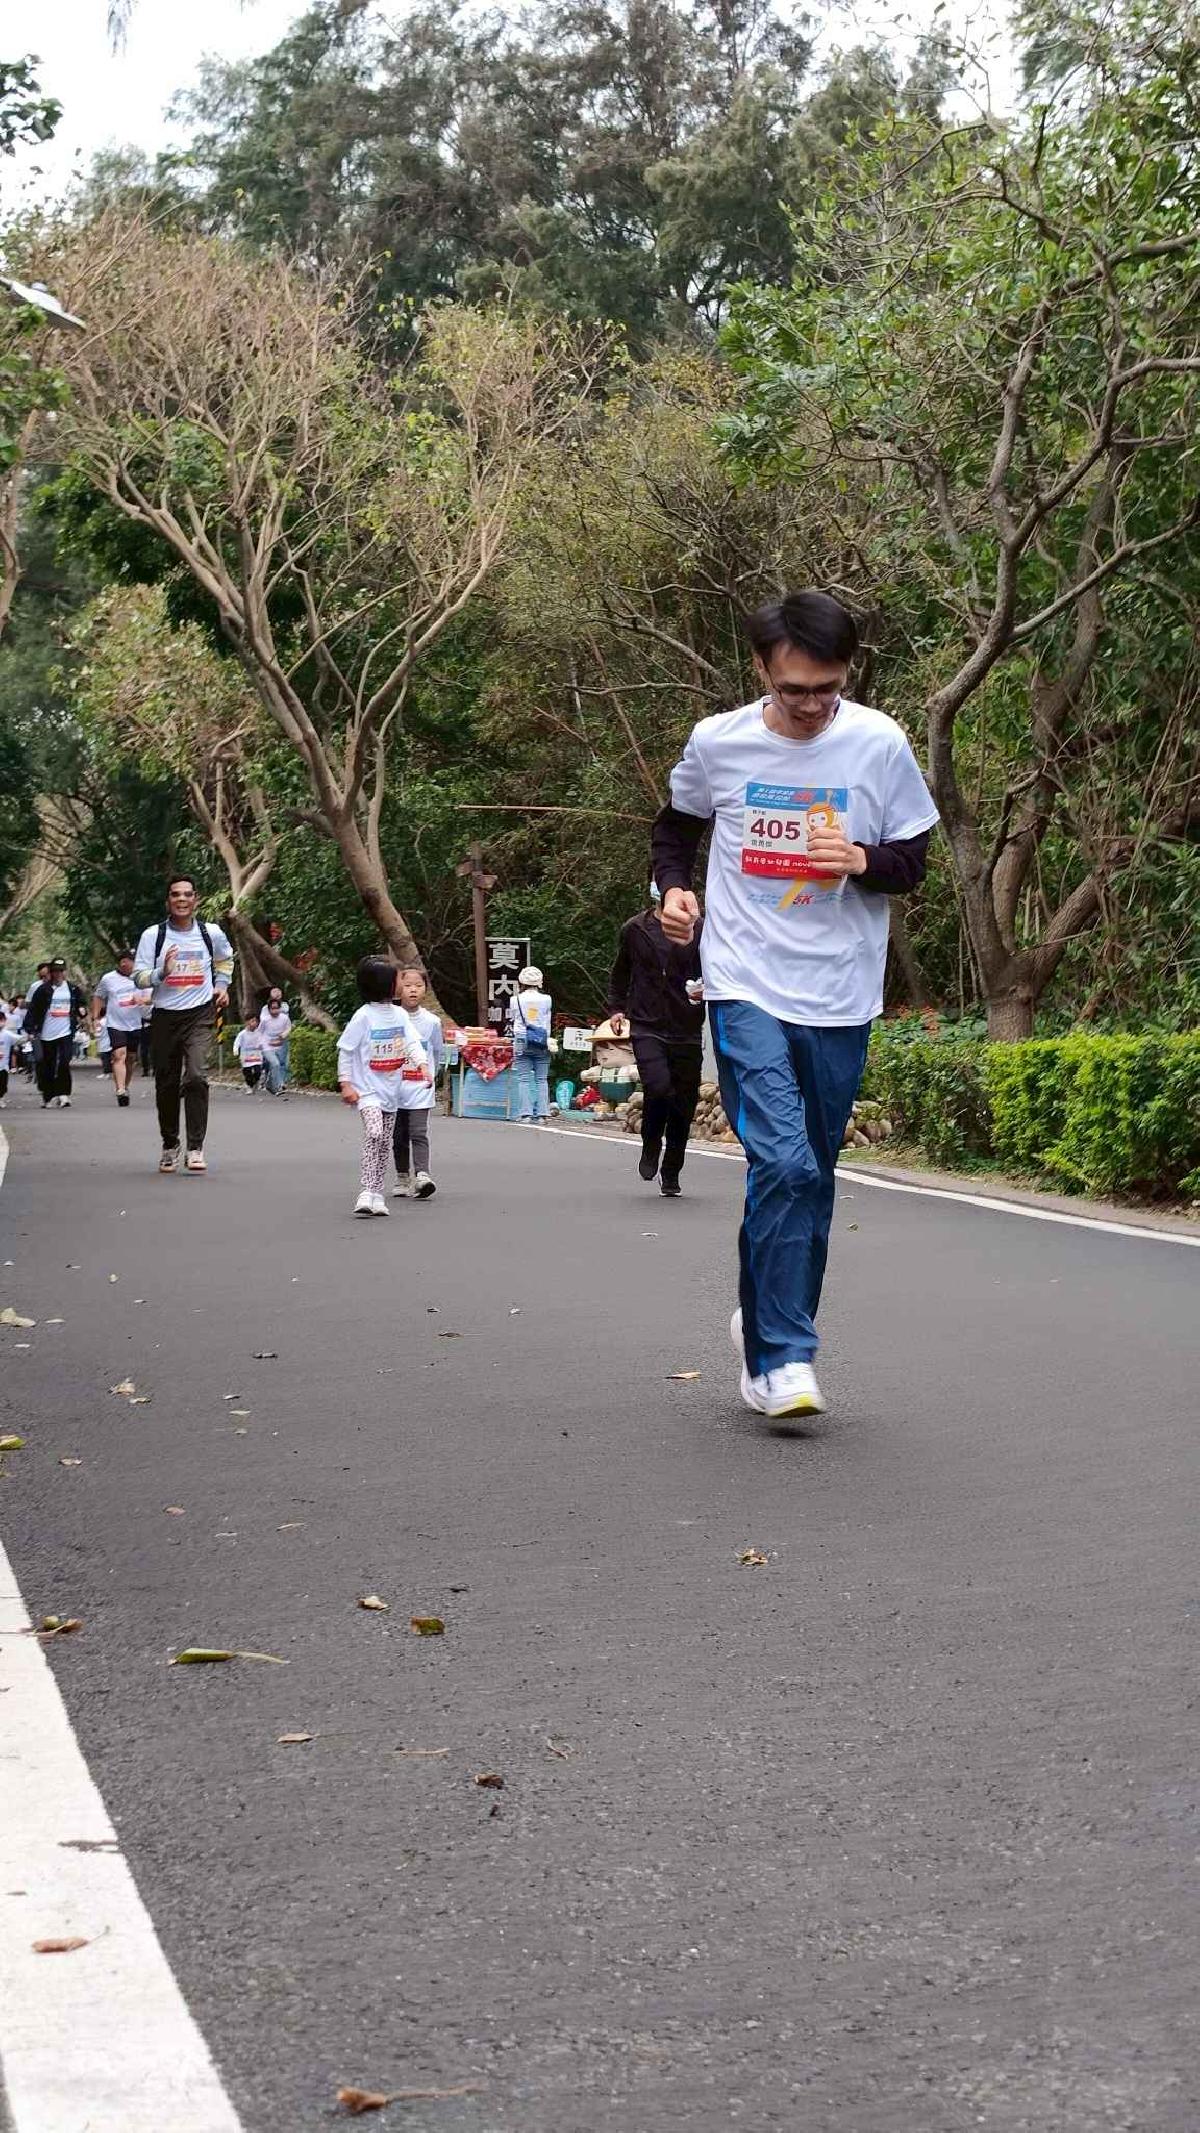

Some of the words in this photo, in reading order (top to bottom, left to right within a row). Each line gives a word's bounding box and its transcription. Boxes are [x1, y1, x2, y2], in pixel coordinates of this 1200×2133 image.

[750, 818, 801, 840] 405
[488, 943, 519, 1001] 莫內
[375, 1043, 393, 1055] 115
